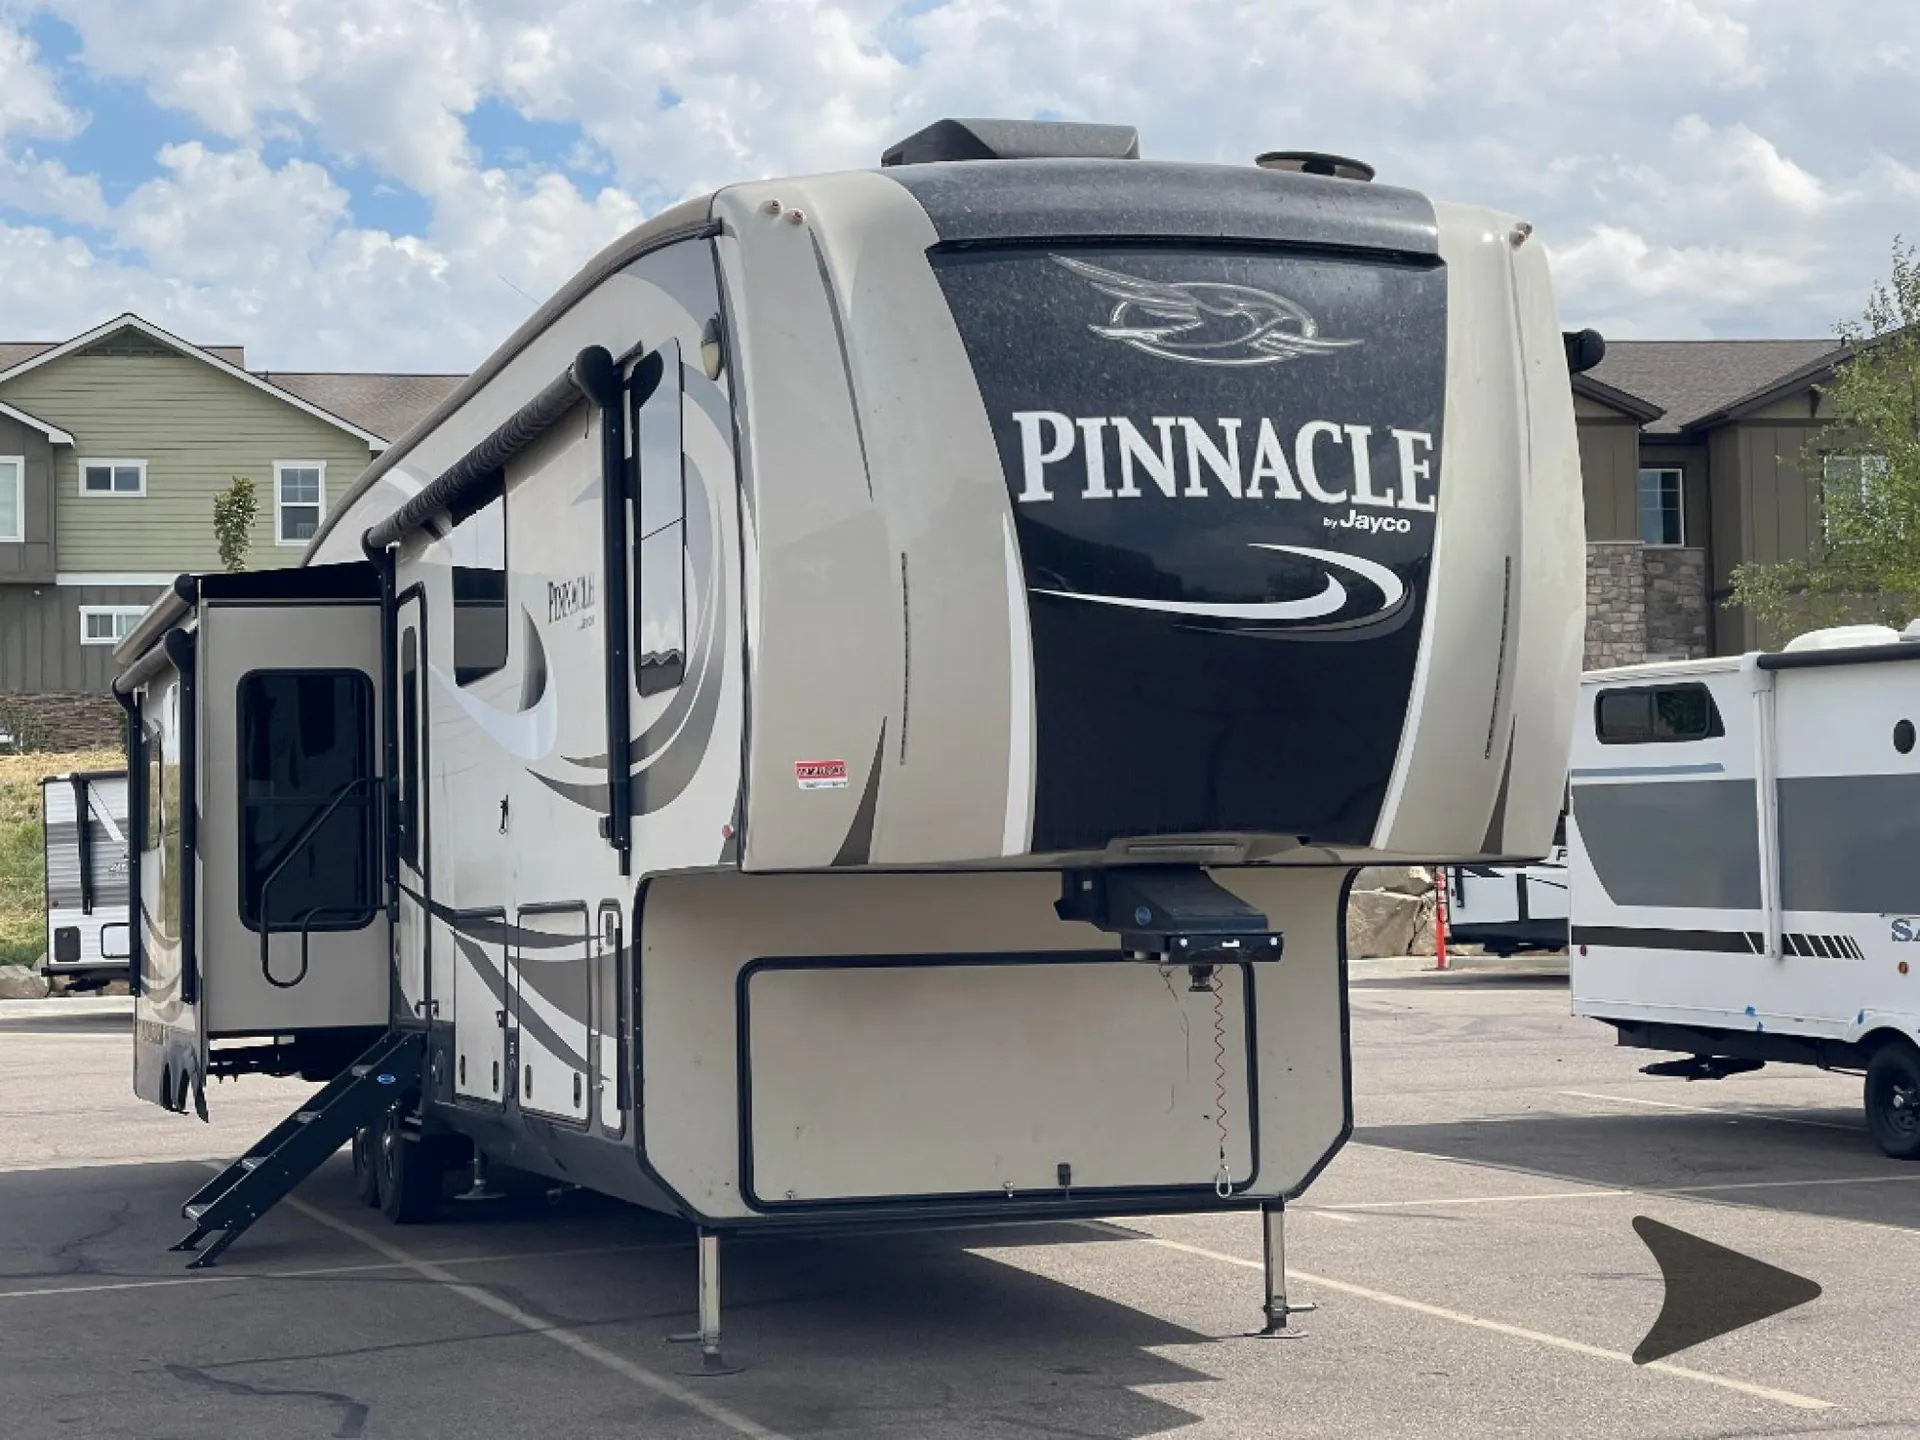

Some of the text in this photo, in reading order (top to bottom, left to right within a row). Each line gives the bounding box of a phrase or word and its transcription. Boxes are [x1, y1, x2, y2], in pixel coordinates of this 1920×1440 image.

[1012, 410, 1436, 512] PINNACLE
[1323, 509, 1411, 534] by Jayco
